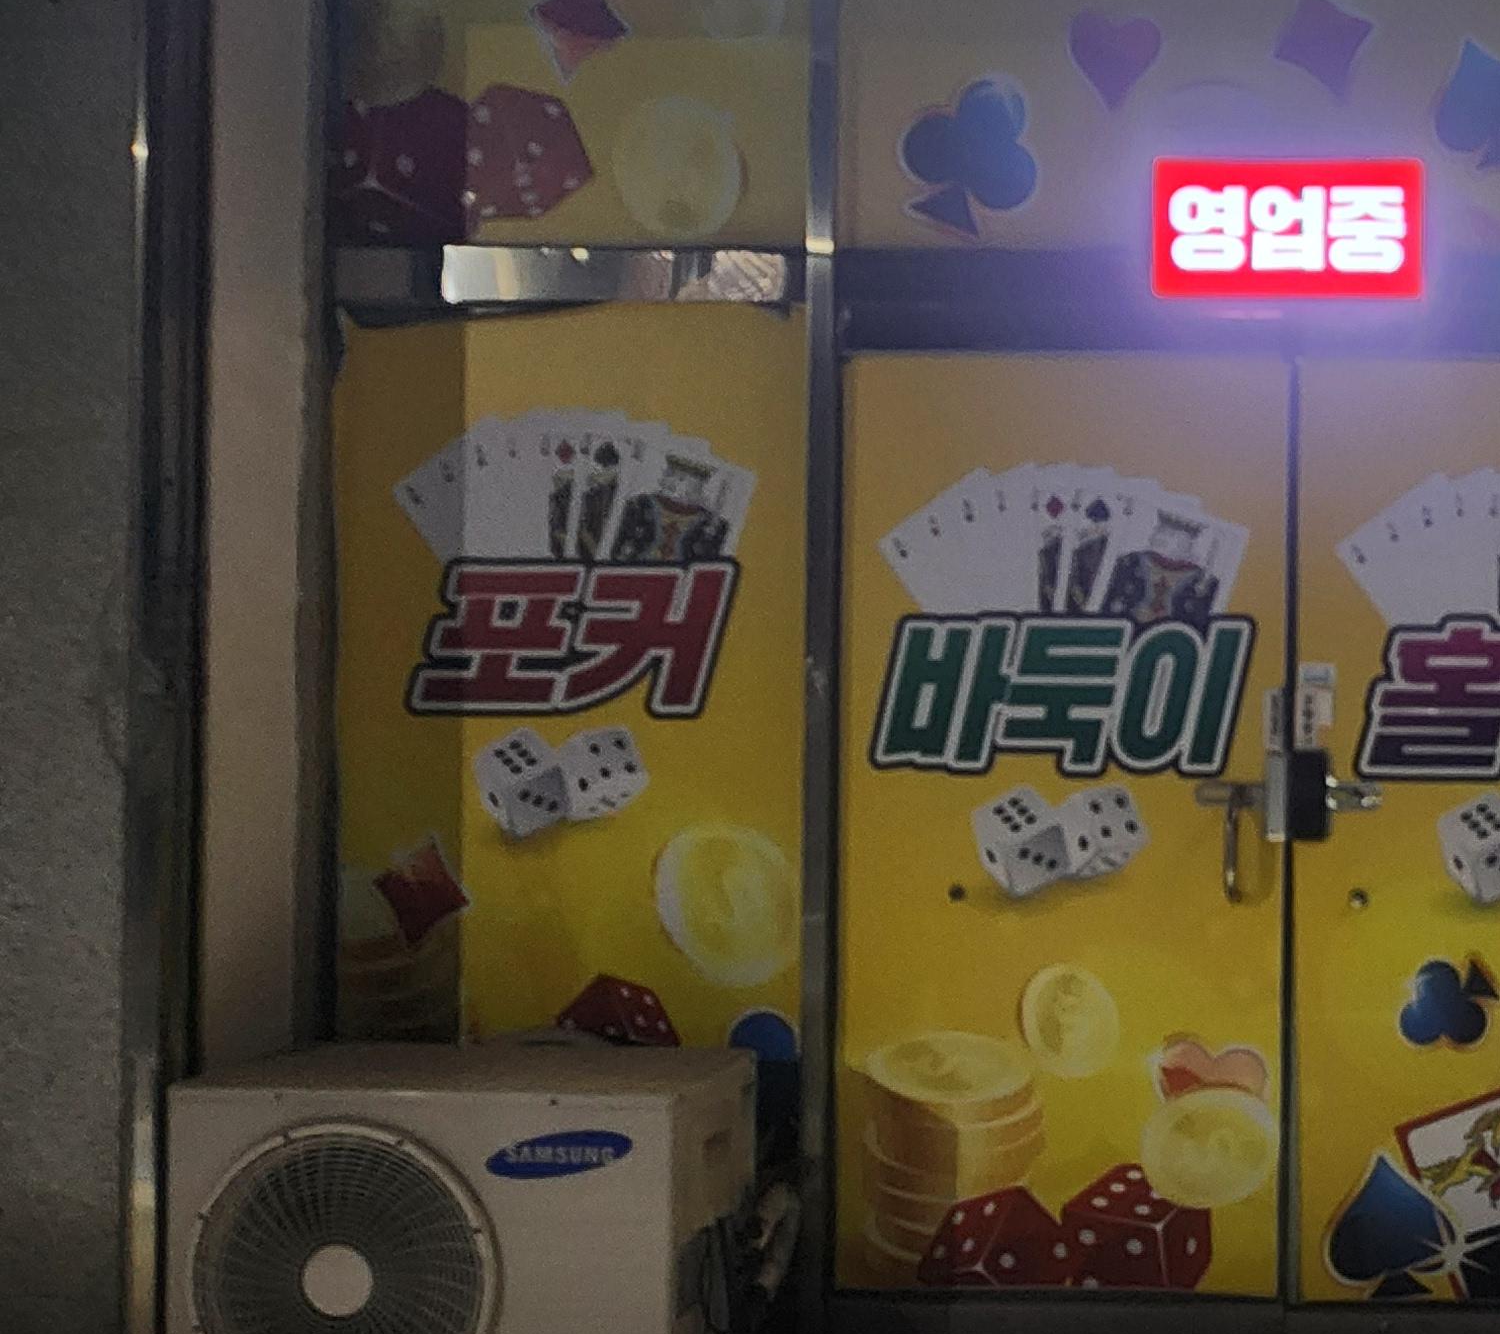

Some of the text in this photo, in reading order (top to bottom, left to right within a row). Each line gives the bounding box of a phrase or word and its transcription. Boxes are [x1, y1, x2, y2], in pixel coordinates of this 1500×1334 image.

[1168, 185, 1407, 273] 영업중
[407, 559, 739, 717] 포커
[872, 615, 1255, 774] 바둑이
[503, 1144, 617, 1165] SAMSUNG
